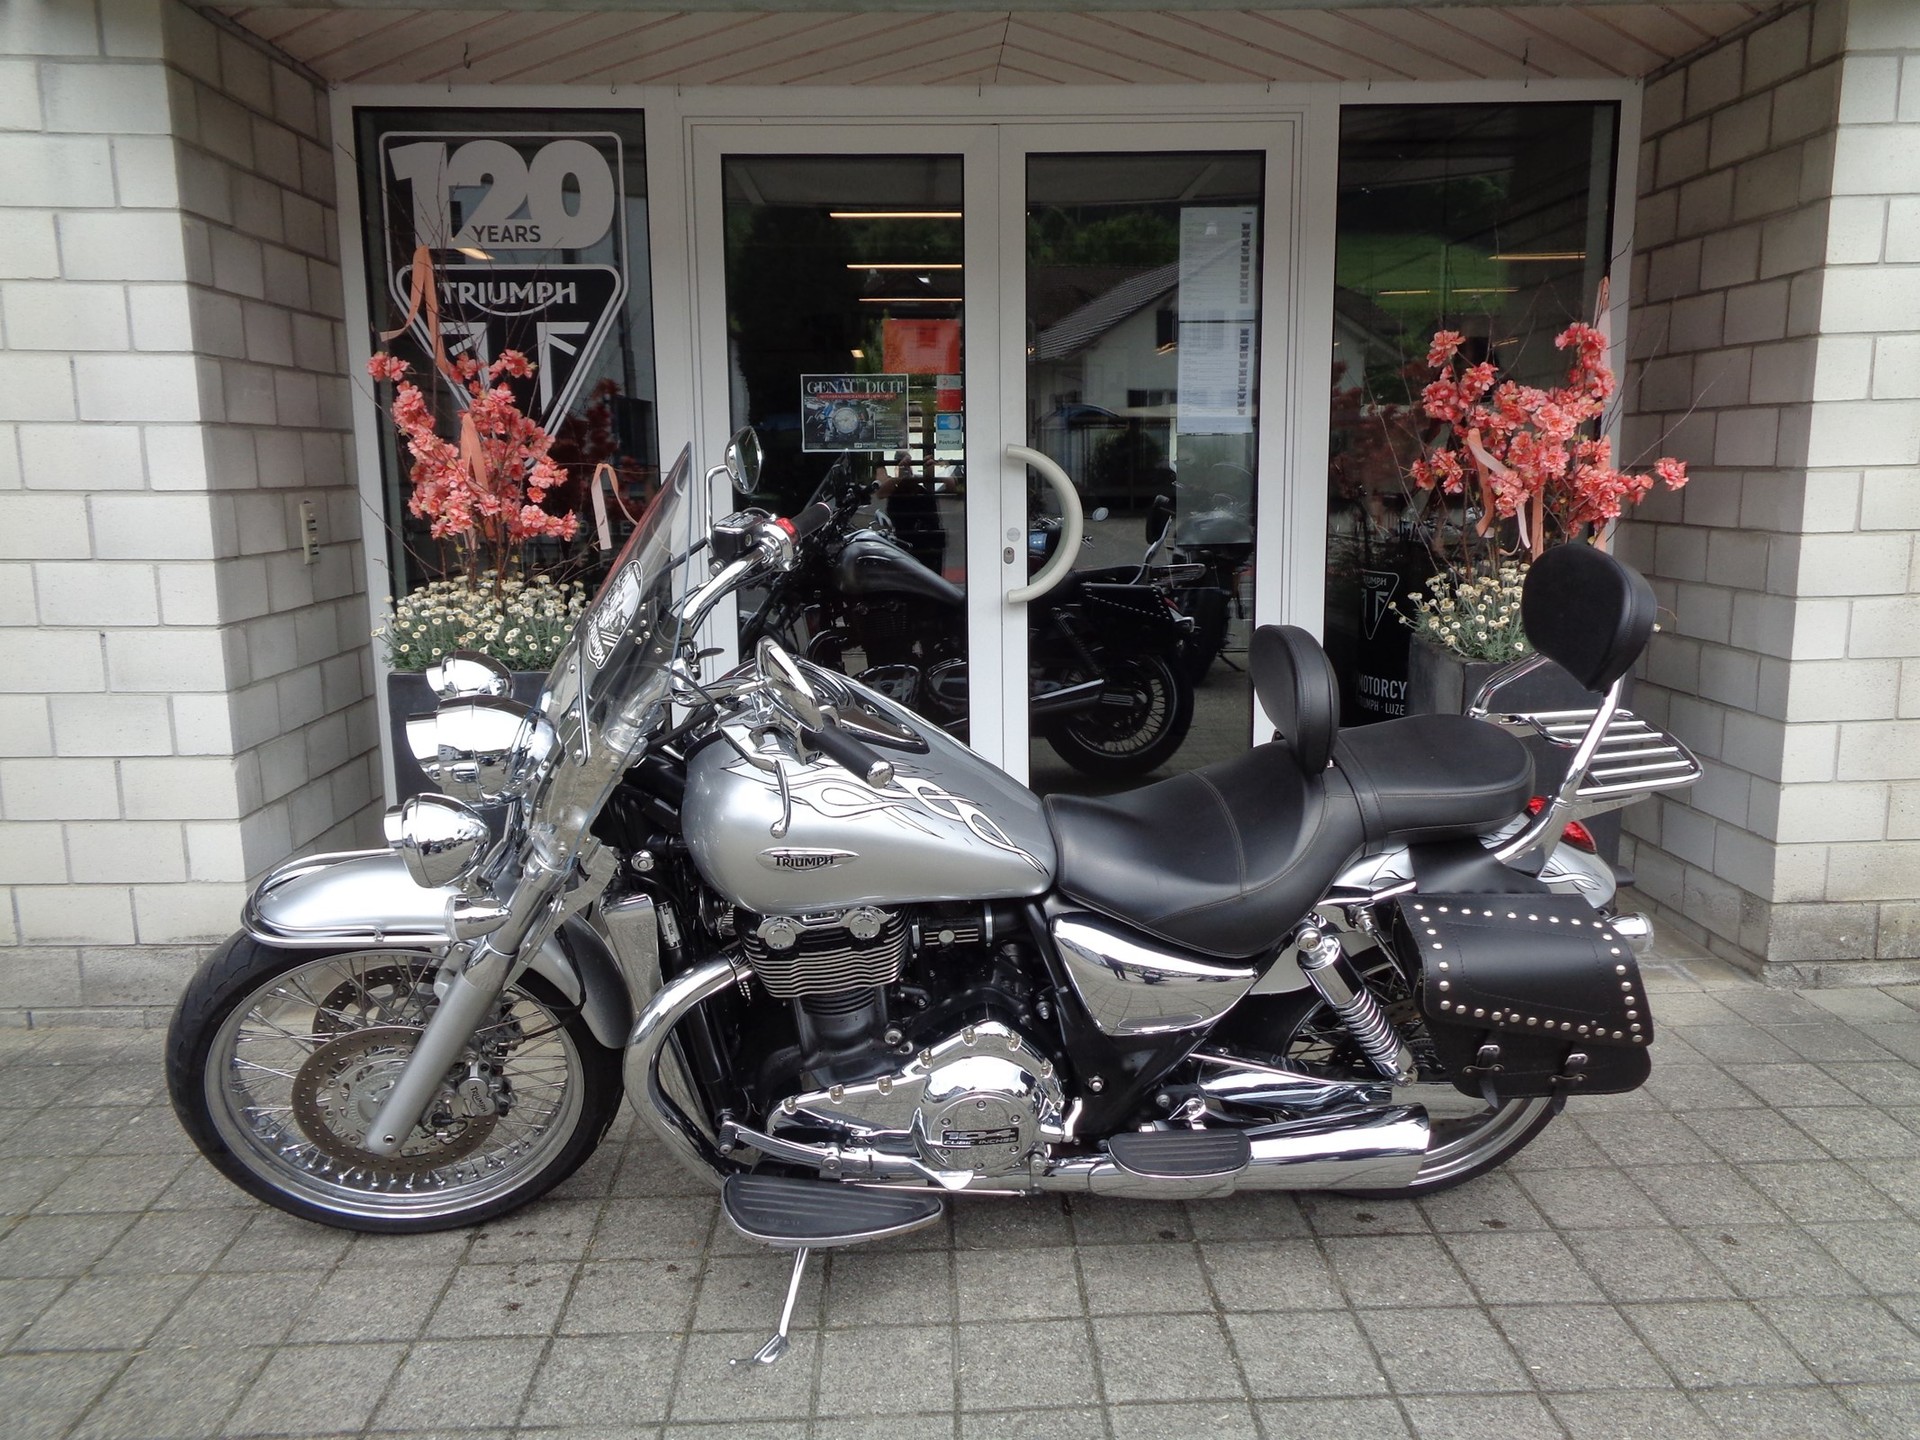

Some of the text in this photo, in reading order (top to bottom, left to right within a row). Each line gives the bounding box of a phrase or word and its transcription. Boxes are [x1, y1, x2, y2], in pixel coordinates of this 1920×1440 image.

[388, 139, 615, 250] 120
[471, 224, 541, 243] YEARS
[438, 281, 577, 306] TRIUMPH
[1359, 673, 1408, 700] MOTORCY
[1385, 702, 1405, 716] LUZE
[773, 855, 835, 869] TRIUMPH
[470, 1085, 488, 1113] TRIUMPH
[978, 1137, 1017, 1145] INCHES
